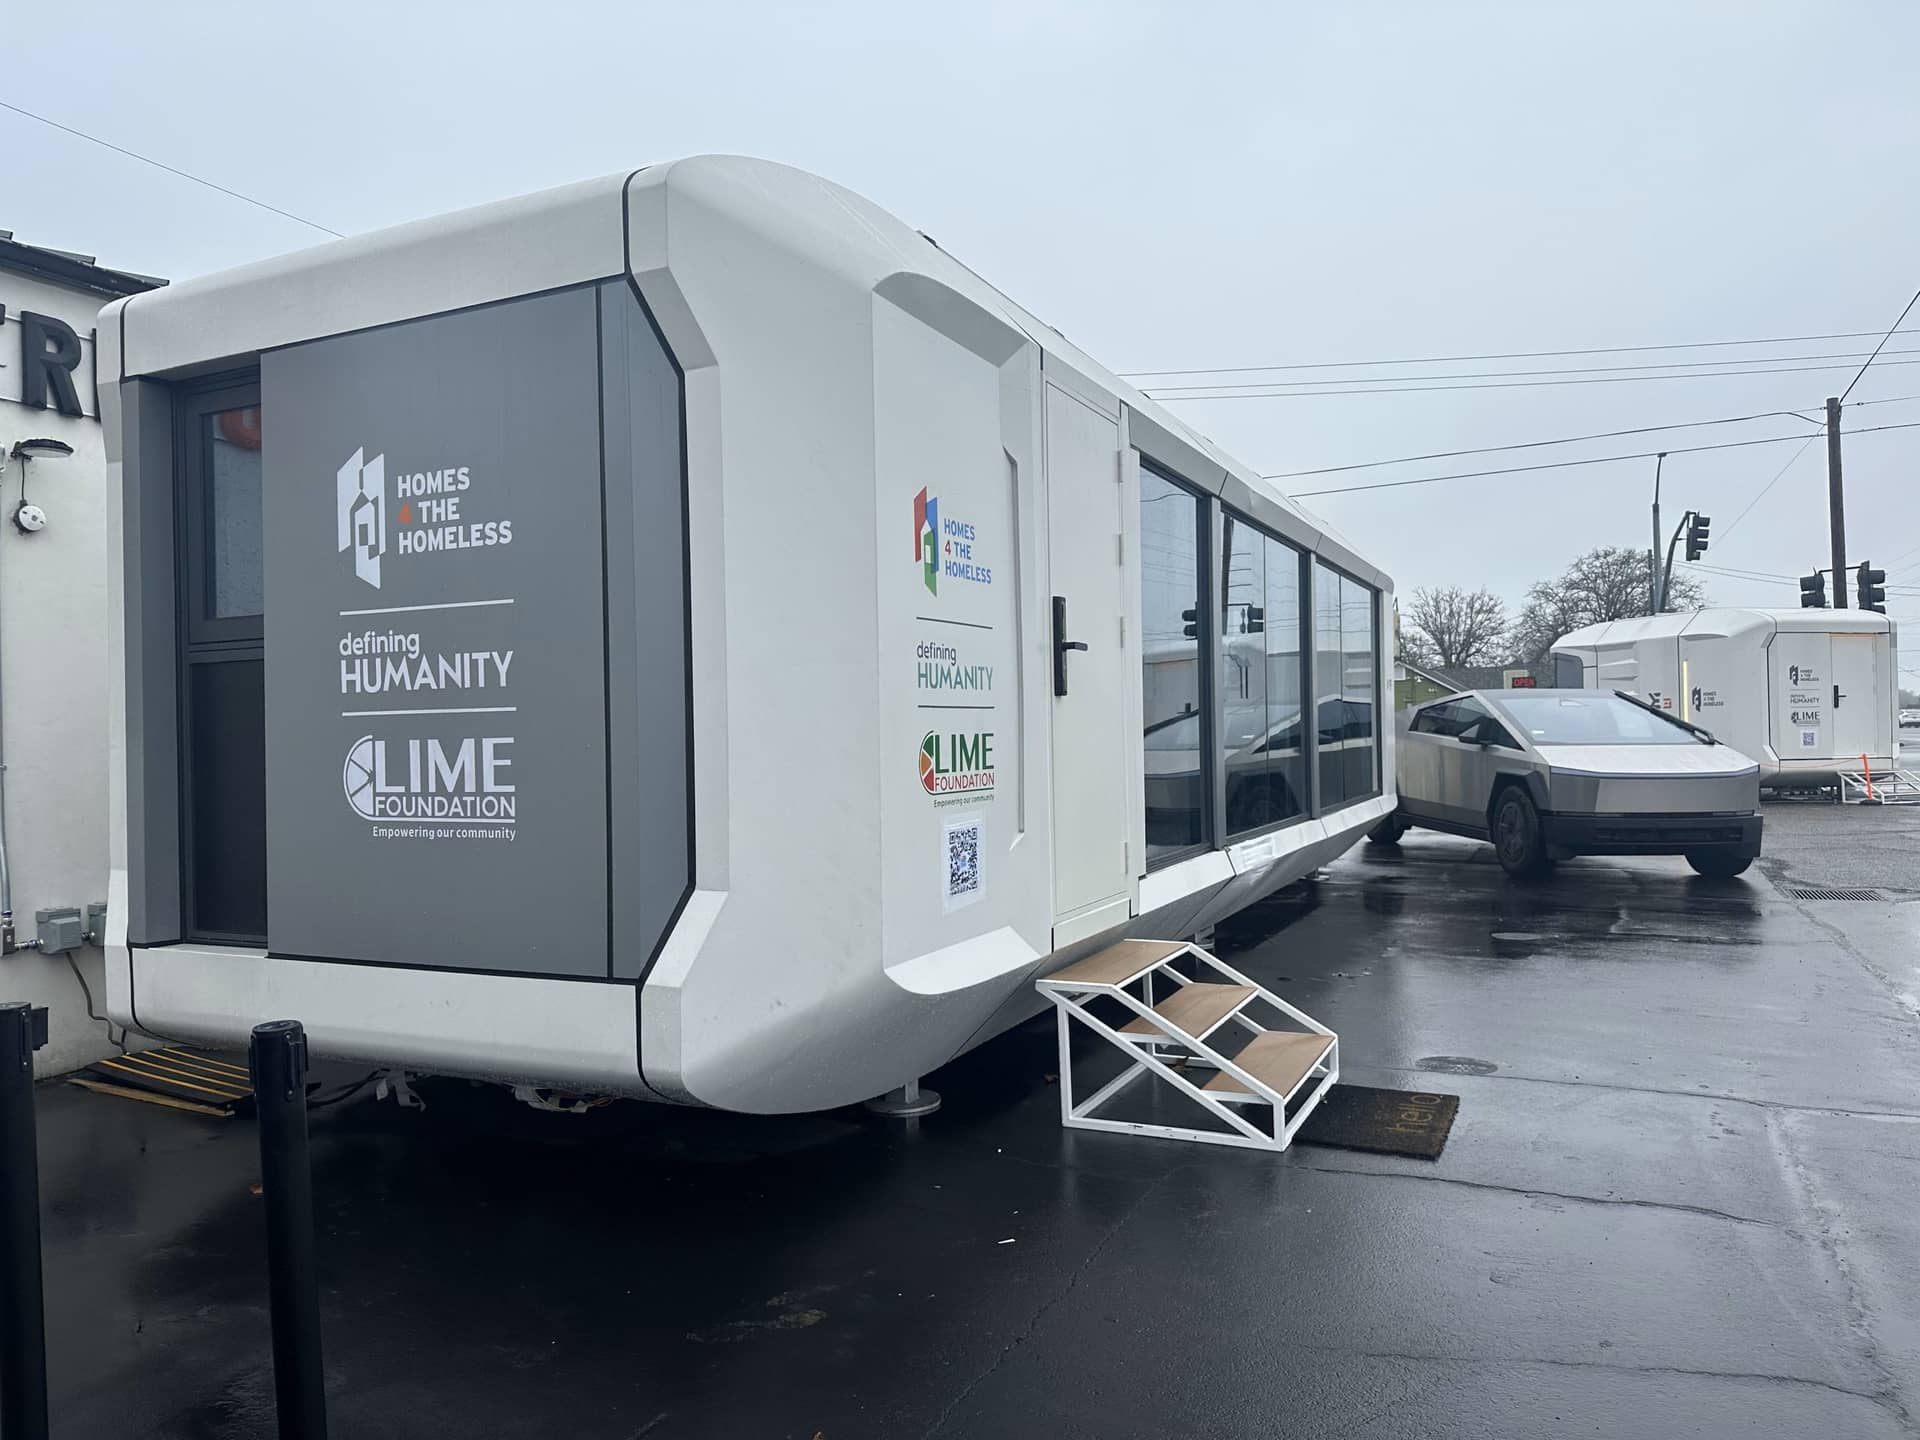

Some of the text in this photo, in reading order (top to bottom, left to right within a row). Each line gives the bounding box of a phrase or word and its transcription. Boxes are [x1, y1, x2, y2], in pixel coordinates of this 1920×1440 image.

[397, 467, 470, 498] HOMES
[398, 497, 460, 525] 4 THE
[398, 520, 512, 554] HOMELESS
[944, 518, 975, 540] HOMES
[945, 539, 971, 560] 4 THE
[945, 560, 991, 584] HOMELESS
[339, 630, 419, 659] defining
[917, 640, 956, 666] defining
[340, 651, 513, 693] HUMANITY
[918, 662, 993, 690] HUMANITY
[1796, 711, 1820, 720] LIME
[375, 737, 516, 793] LIME
[935, 733, 994, 773] LIME
[935, 772, 994, 792] FOUNDATION
[375, 796, 516, 817] FOUNDATION
[373, 826, 516, 841] Empowering our community
